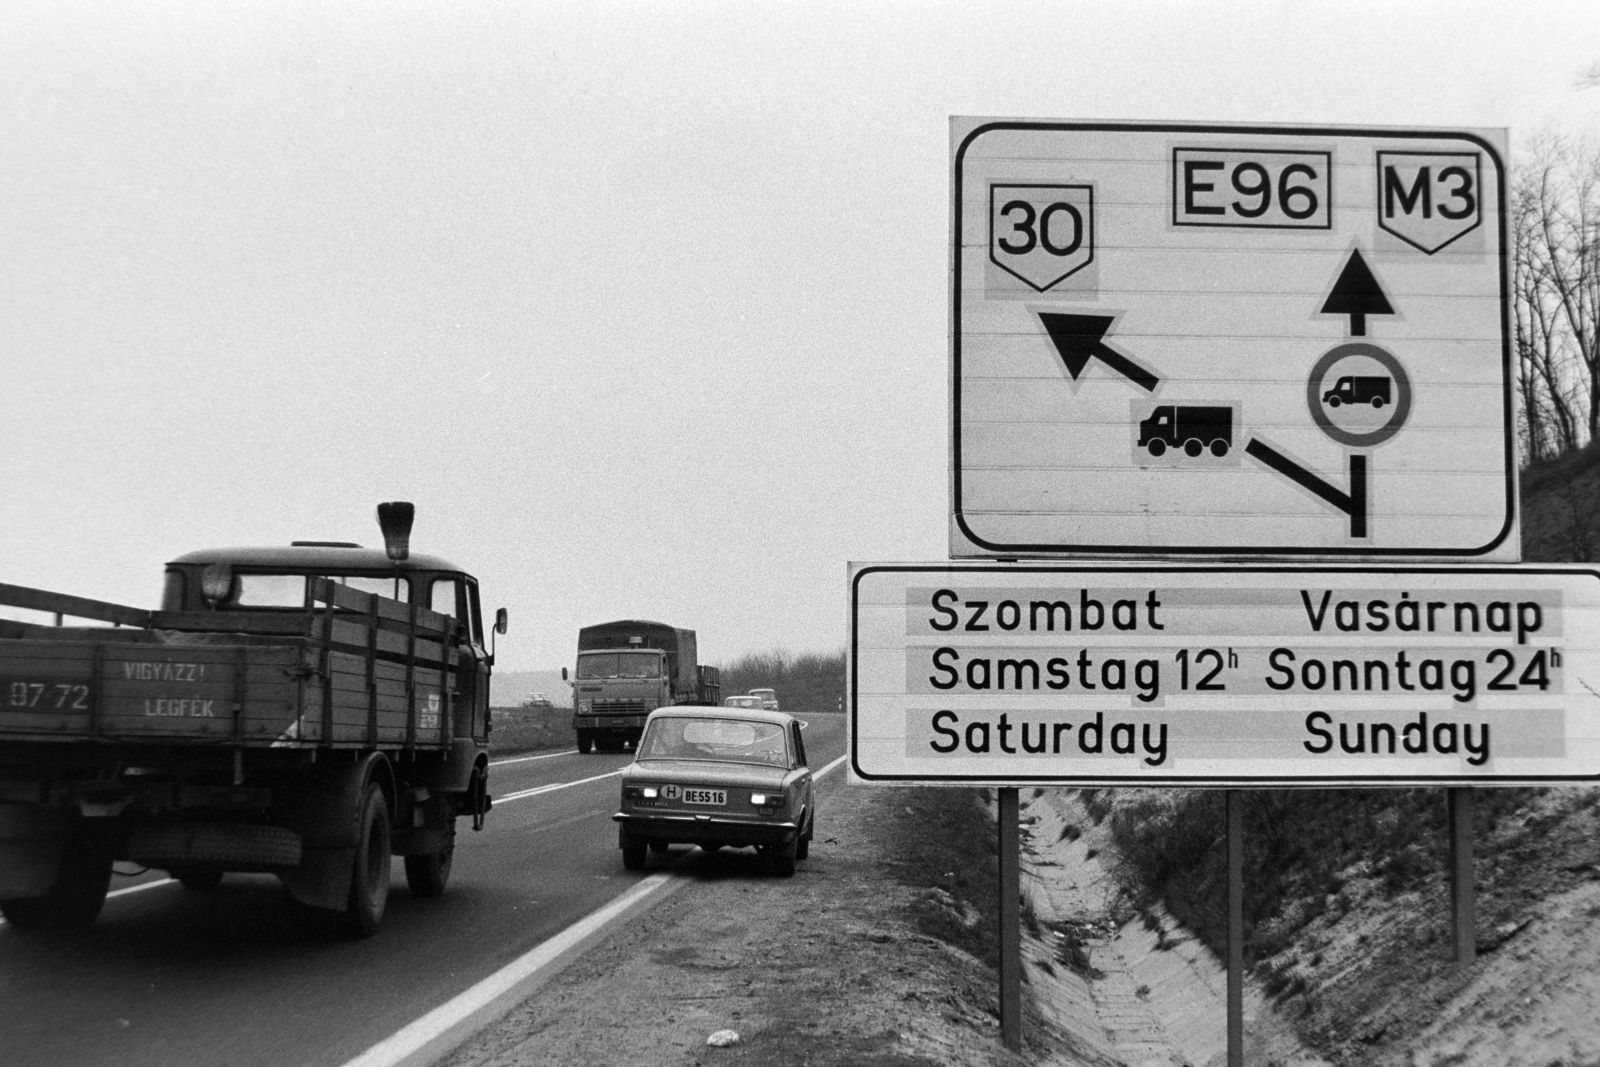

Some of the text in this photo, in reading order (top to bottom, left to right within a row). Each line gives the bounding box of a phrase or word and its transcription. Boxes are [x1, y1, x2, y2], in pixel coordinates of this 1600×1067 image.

[1184, 160, 1318, 220] E96
[1384, 165, 1476, 220] M3
[998, 199, 1083, 257] 30
[928, 588, 1542, 645] Szombat Vasárnap
[929, 646, 1160, 703] Samstag
[1264, 647, 1476, 703] Sonntag
[929, 710, 1490, 767] Saturday Sunday
[666, 785, 677, 798] H
